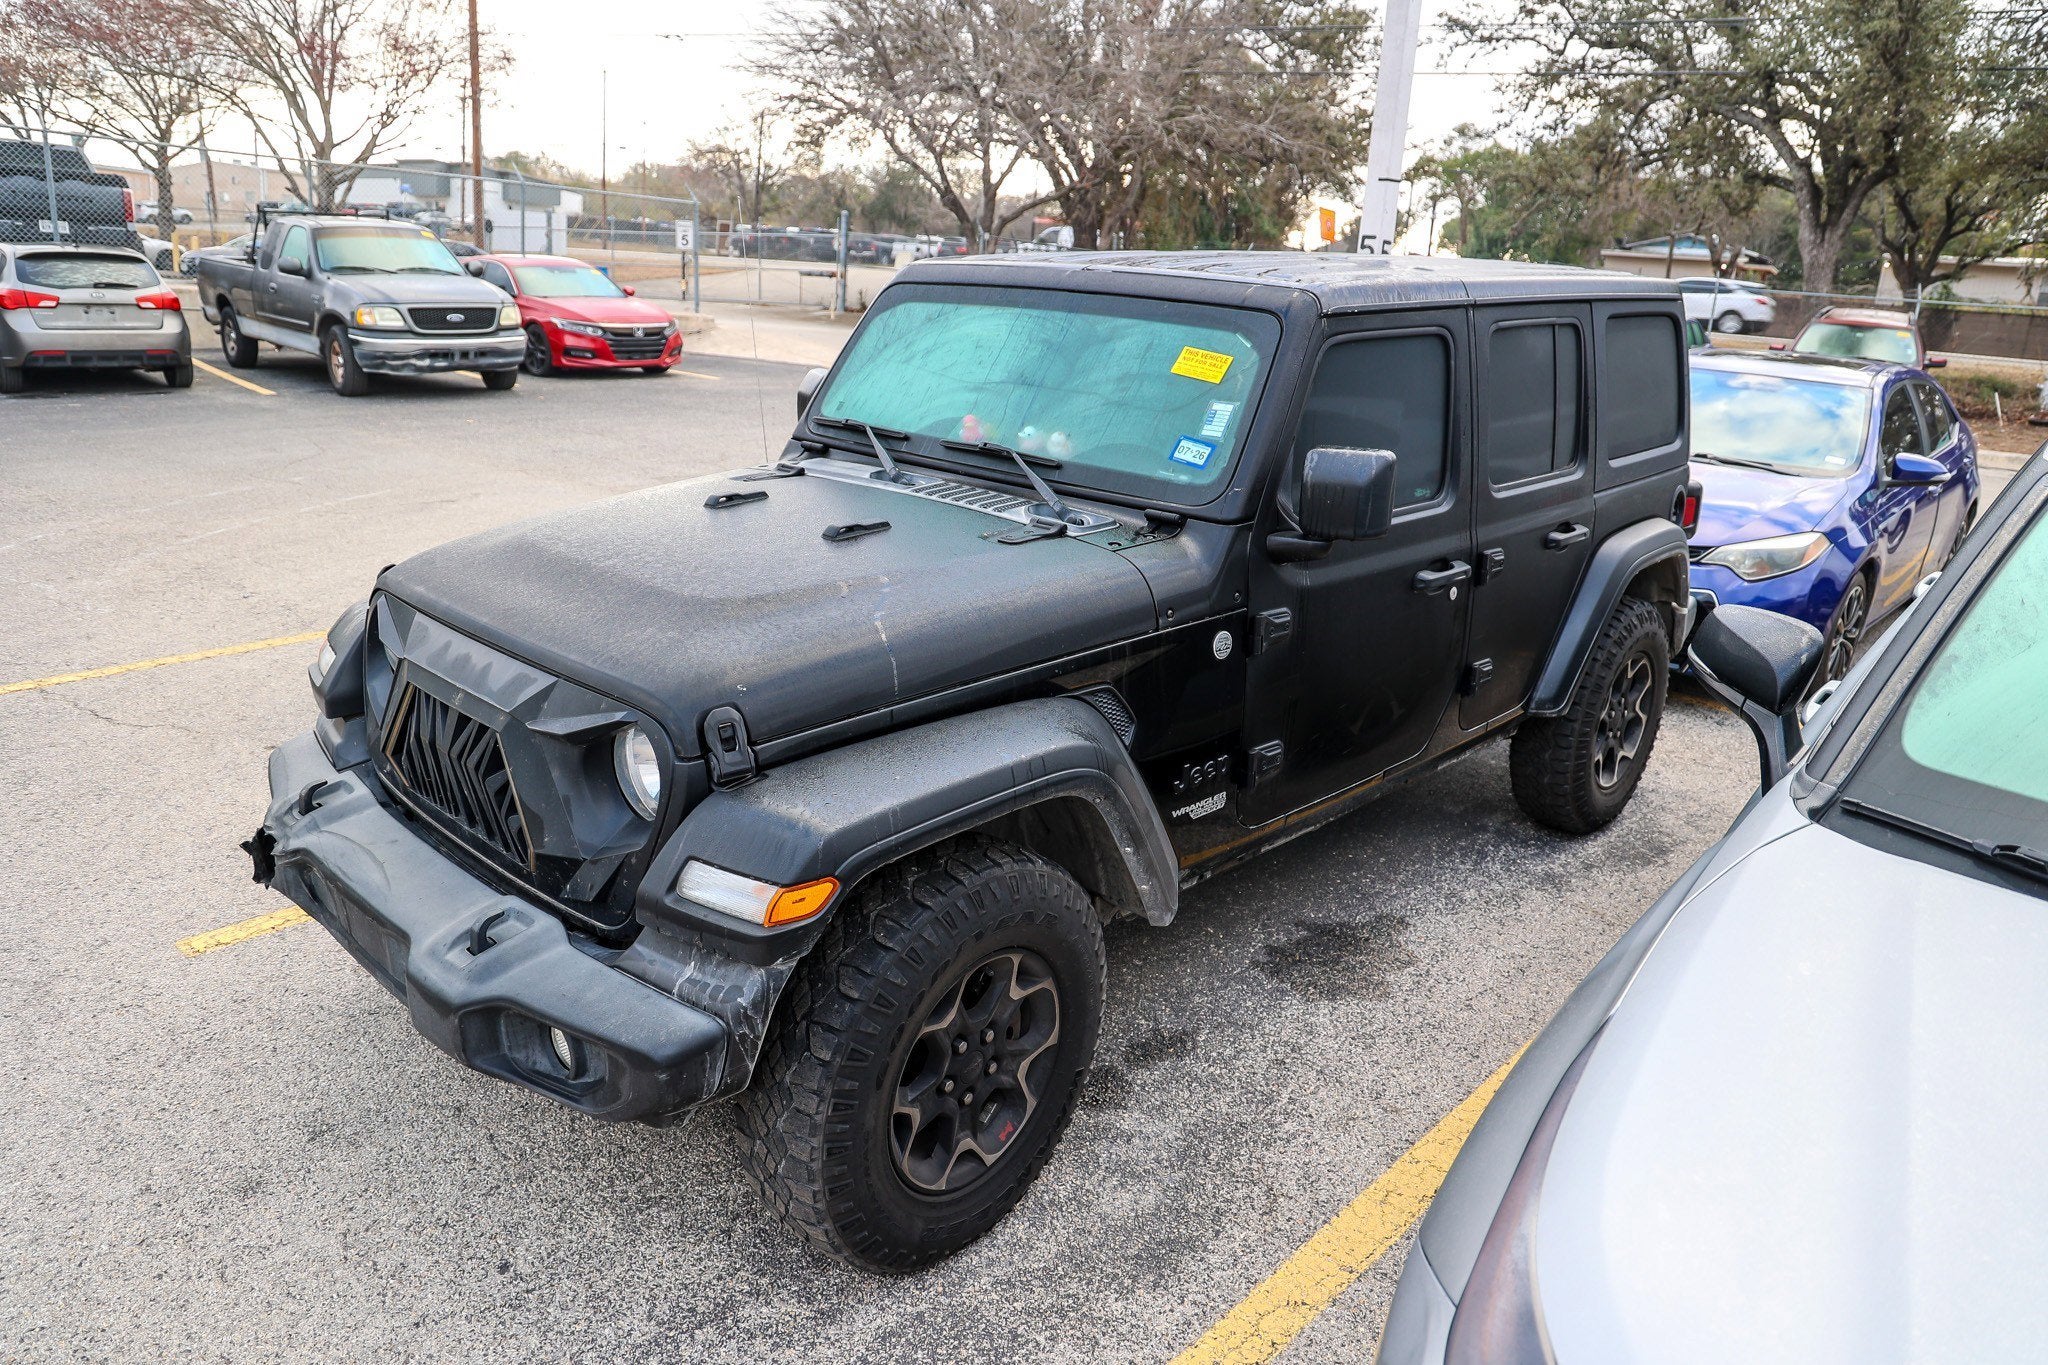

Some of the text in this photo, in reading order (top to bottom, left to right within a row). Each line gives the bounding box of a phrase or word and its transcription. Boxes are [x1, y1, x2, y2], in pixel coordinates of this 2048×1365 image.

[681, 234, 689, 246] 5
[1184, 348, 1230, 365] THIS VEHICLE
[1195, 358, 1208, 366] FOR
[1207, 361, 1224, 369] SALE
[1173, 754, 1229, 796] Jeep
[1171, 791, 1227, 818] WRANGLER
